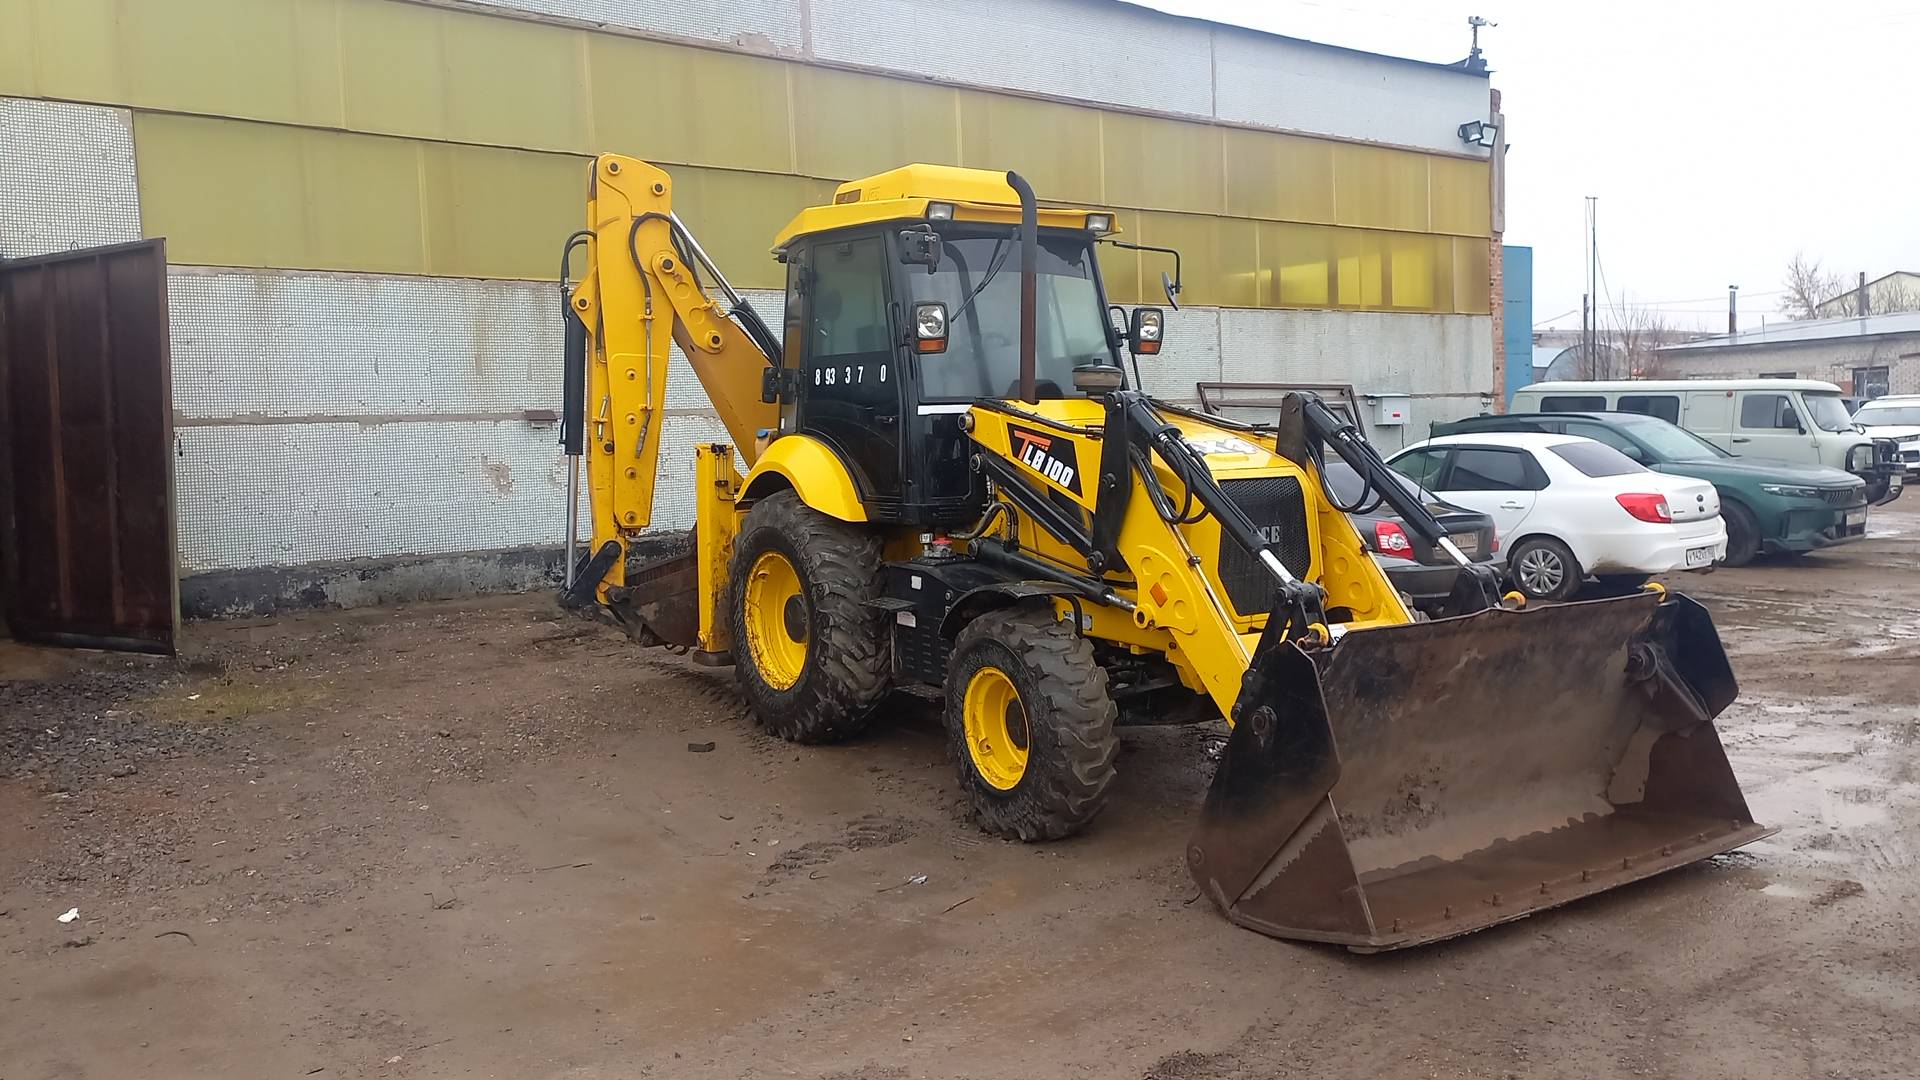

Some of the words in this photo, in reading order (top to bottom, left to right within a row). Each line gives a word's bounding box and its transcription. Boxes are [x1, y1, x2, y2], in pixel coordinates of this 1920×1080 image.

[815, 368, 821, 386] 8
[825, 367, 836, 385] 93
[845, 366, 851, 384] 3
[857, 366, 864, 383] 7
[880, 364, 887, 382] 0
[1043, 456, 1075, 488] 100
